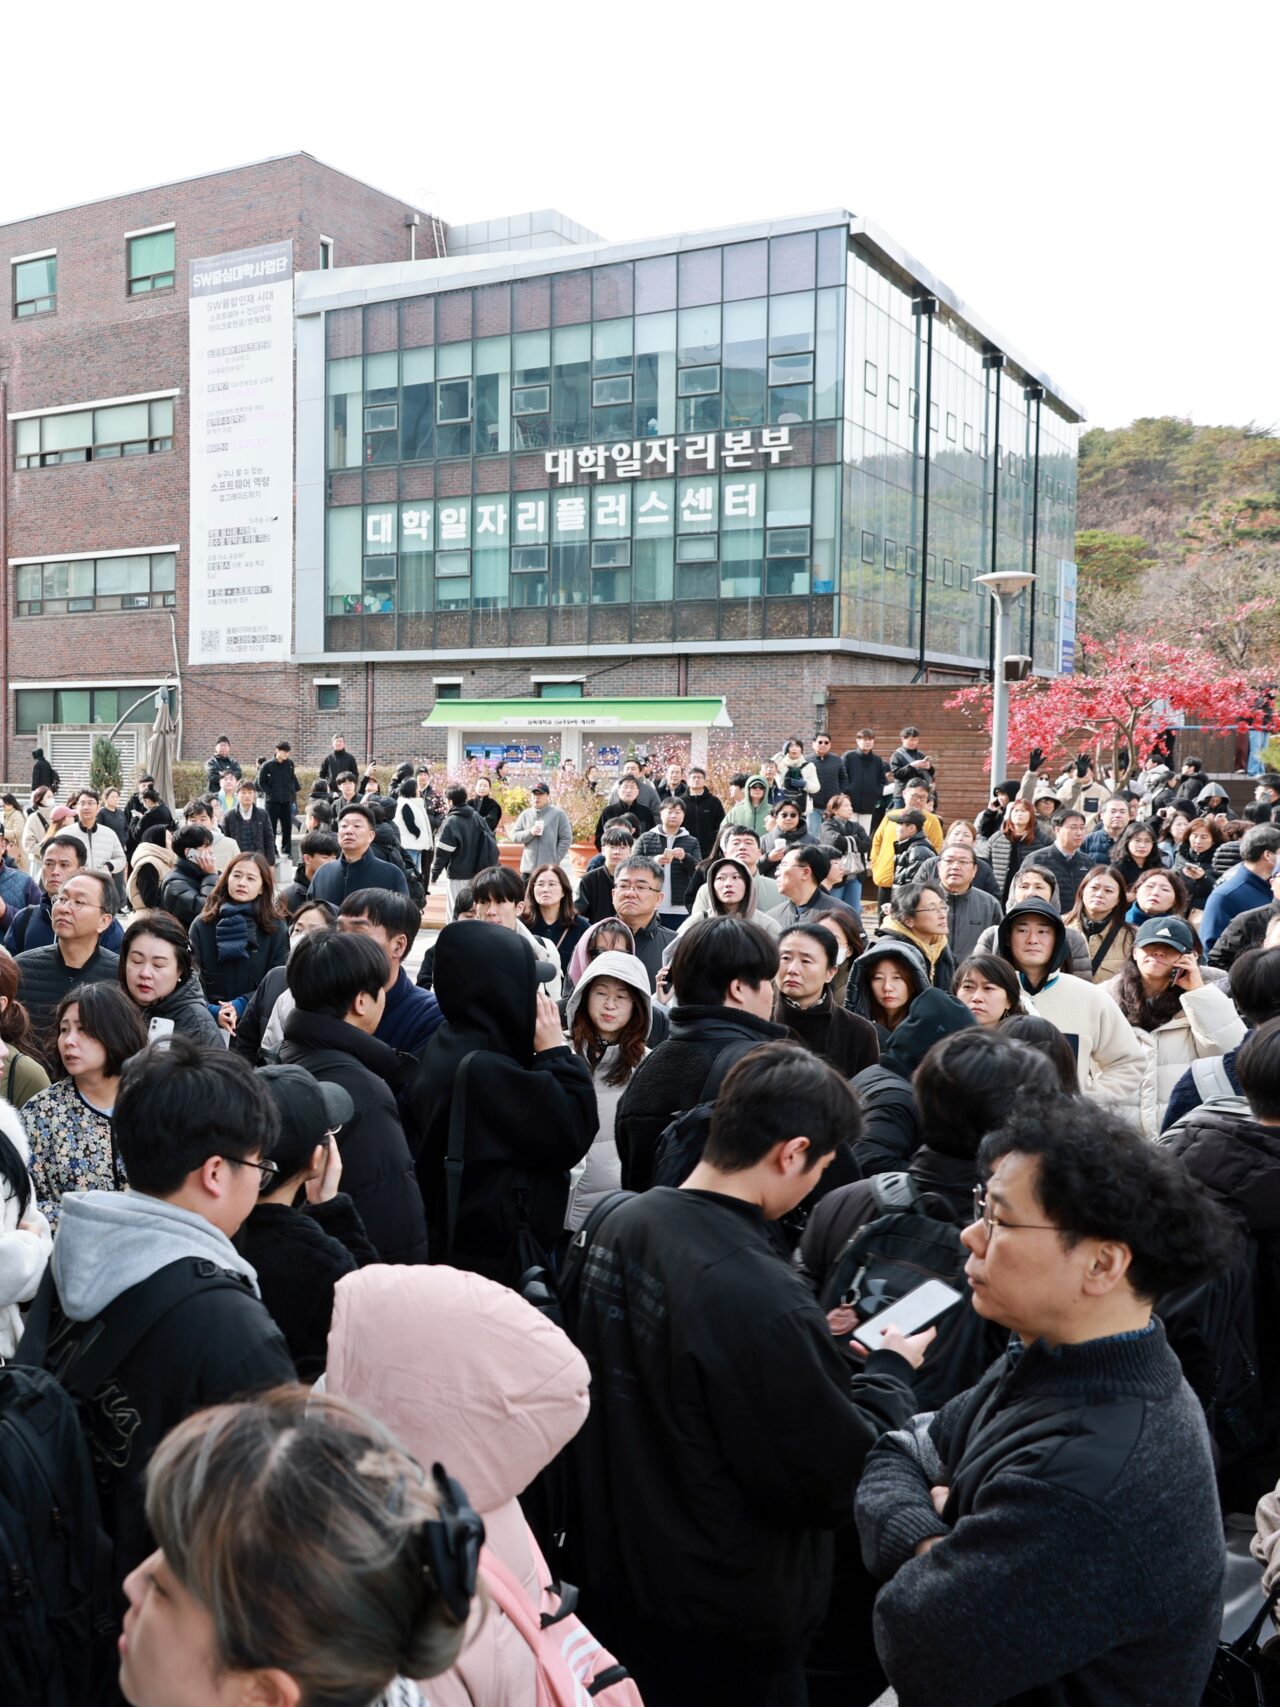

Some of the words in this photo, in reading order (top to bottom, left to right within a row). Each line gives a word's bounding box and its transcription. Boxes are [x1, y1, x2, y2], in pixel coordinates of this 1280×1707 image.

[544, 427, 794, 484] 대학일자리본부
[211, 478, 251, 492] 소프트웨어
[366, 483, 758, 543] 대학일자리플러스센터
